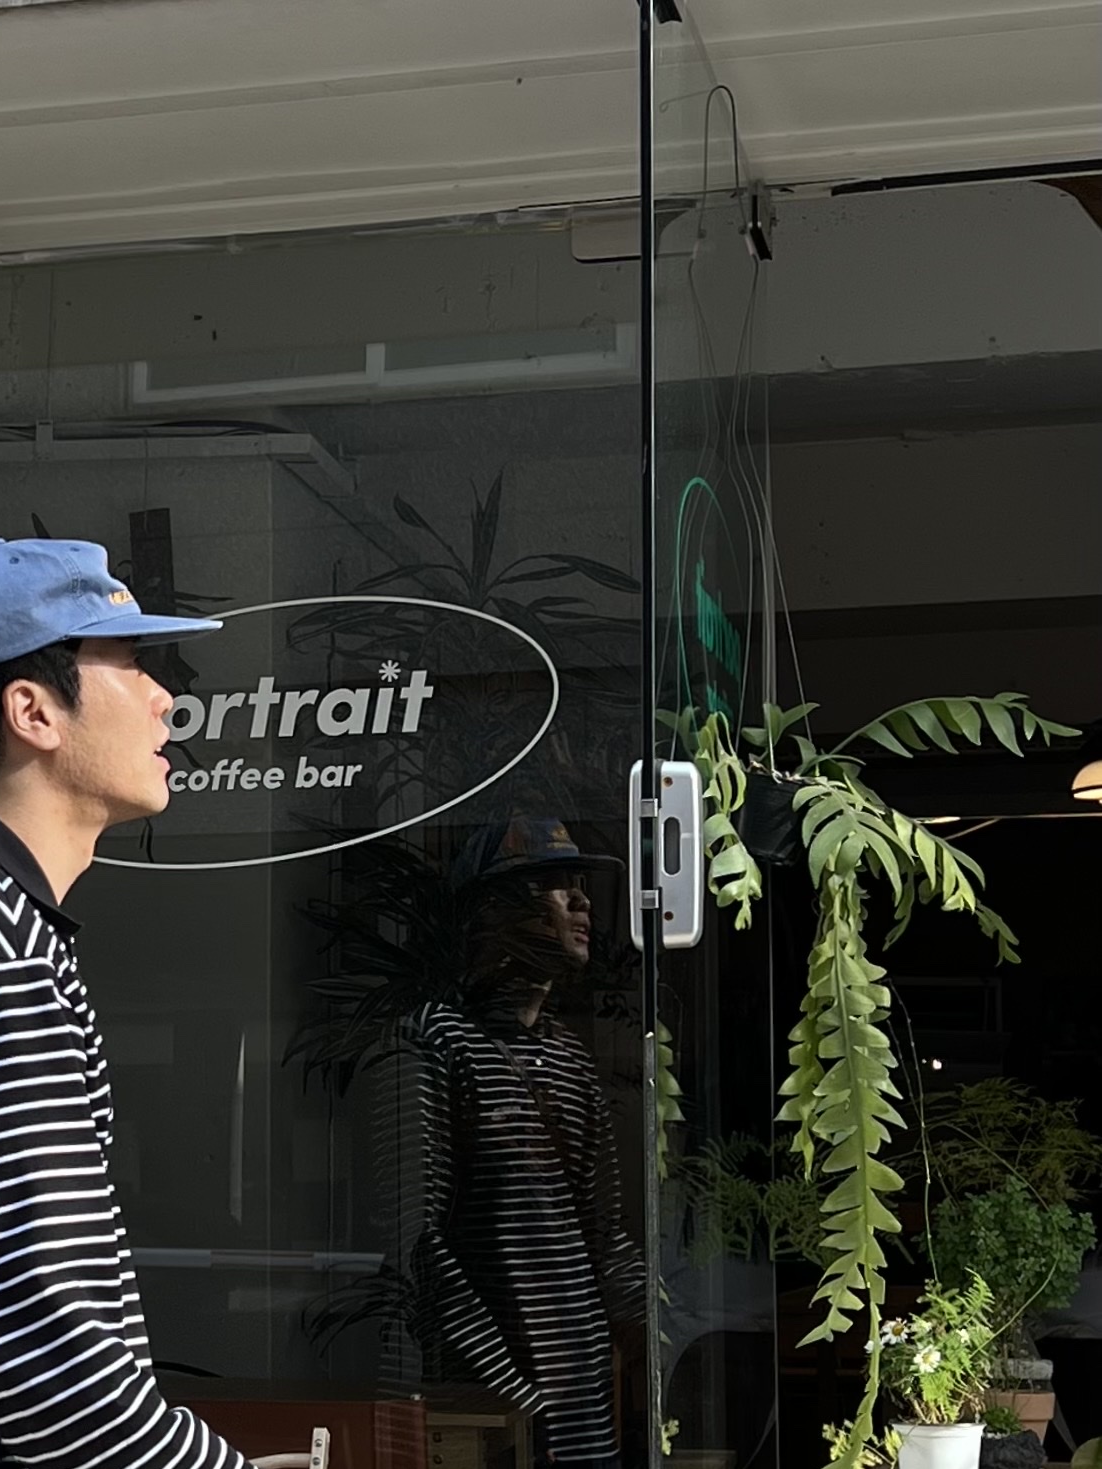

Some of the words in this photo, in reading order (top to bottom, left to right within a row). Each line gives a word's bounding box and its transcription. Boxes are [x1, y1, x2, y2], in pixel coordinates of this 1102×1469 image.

[161, 660, 435, 742] ortrait
[167, 757, 286, 793] coffee
[294, 755, 363, 789] bar
